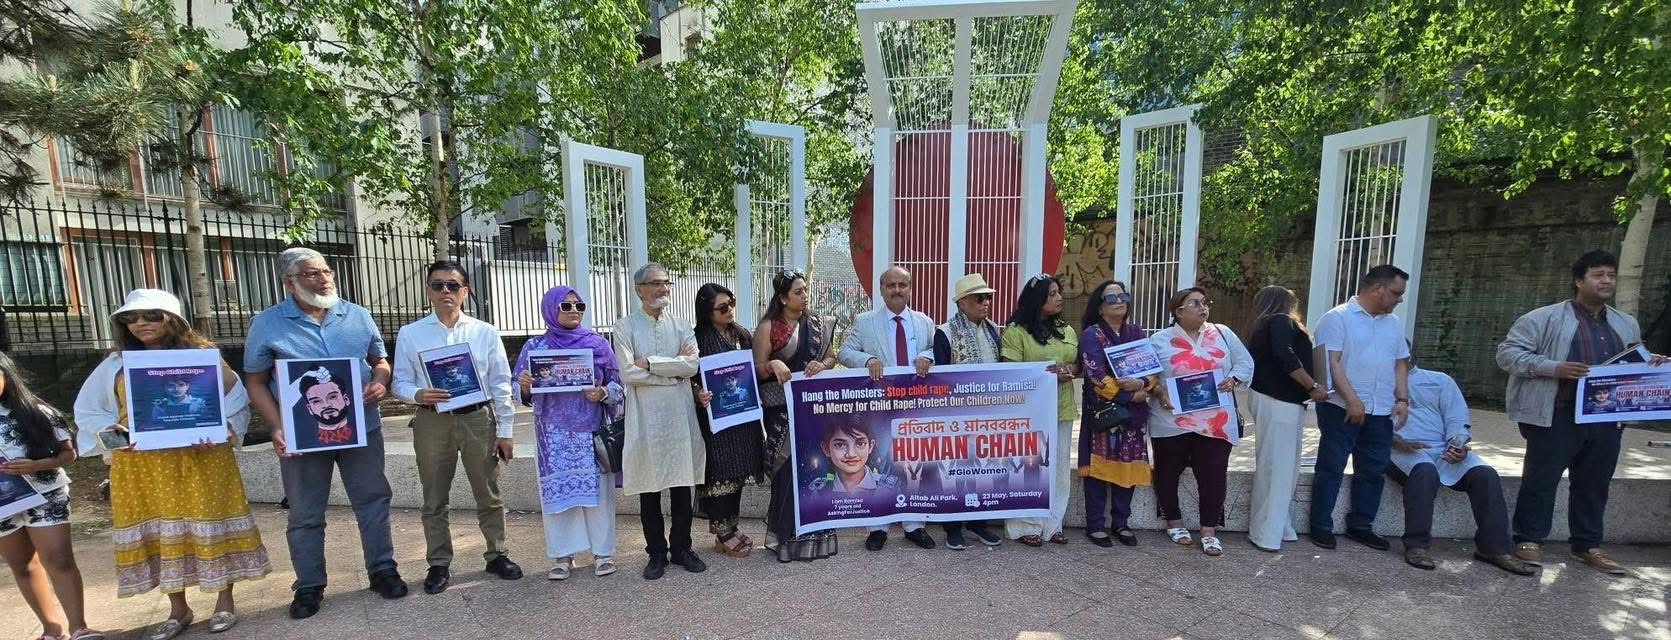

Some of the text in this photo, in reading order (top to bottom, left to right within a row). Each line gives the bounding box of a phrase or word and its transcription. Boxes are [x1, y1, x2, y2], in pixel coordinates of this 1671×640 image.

[802, 380, 1036, 402] Hang the Monsters: Stop child rape, Justice for Ramisa!
[1616, 390, 1643, 399] HUMAN
[813, 394, 1025, 414] No Mercy for Child Rape! Protect Our Children Now!
[898, 418, 1031, 436] প্রতিবাদ ও মানববন্ধন
[892, 432, 1038, 462] HUMAN CHAIN
[948, 467, 1008, 476] #GloWomen
